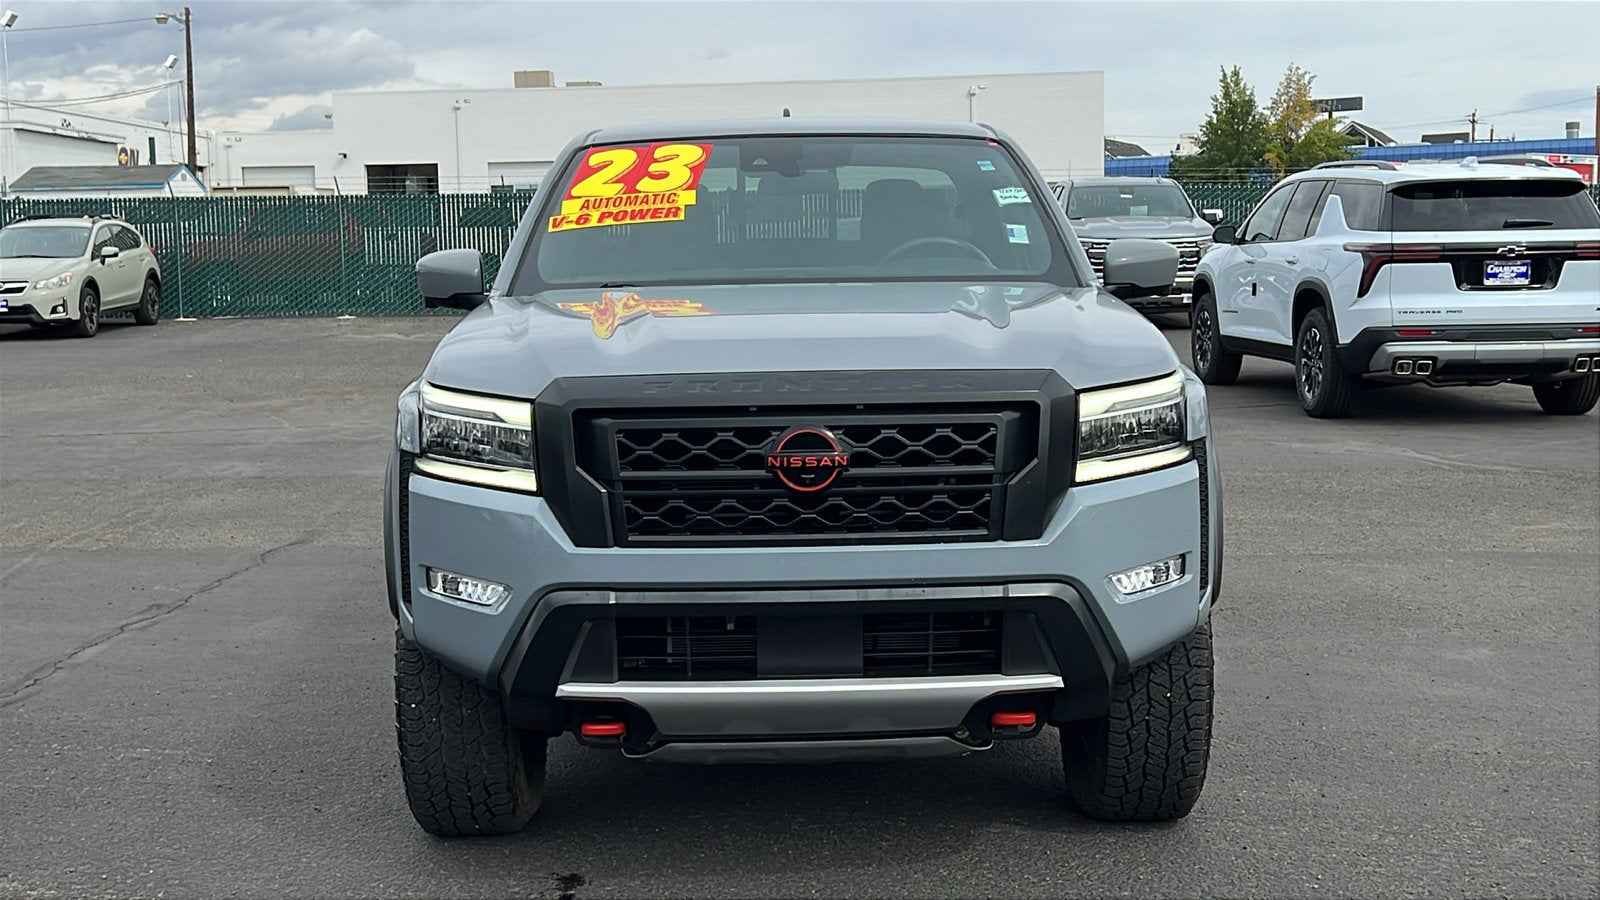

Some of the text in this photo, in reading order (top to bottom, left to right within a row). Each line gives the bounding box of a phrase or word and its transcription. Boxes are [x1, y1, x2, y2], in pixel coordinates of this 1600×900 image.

[571, 144, 706, 197] 23
[580, 192, 679, 211] AUTOMATIC
[551, 206, 683, 229] V-6 POWER
[1487, 264, 1527, 274] CHAMPION
[643, 377, 974, 395] FRONTIER
[767, 456, 848, 467] NISSAN
